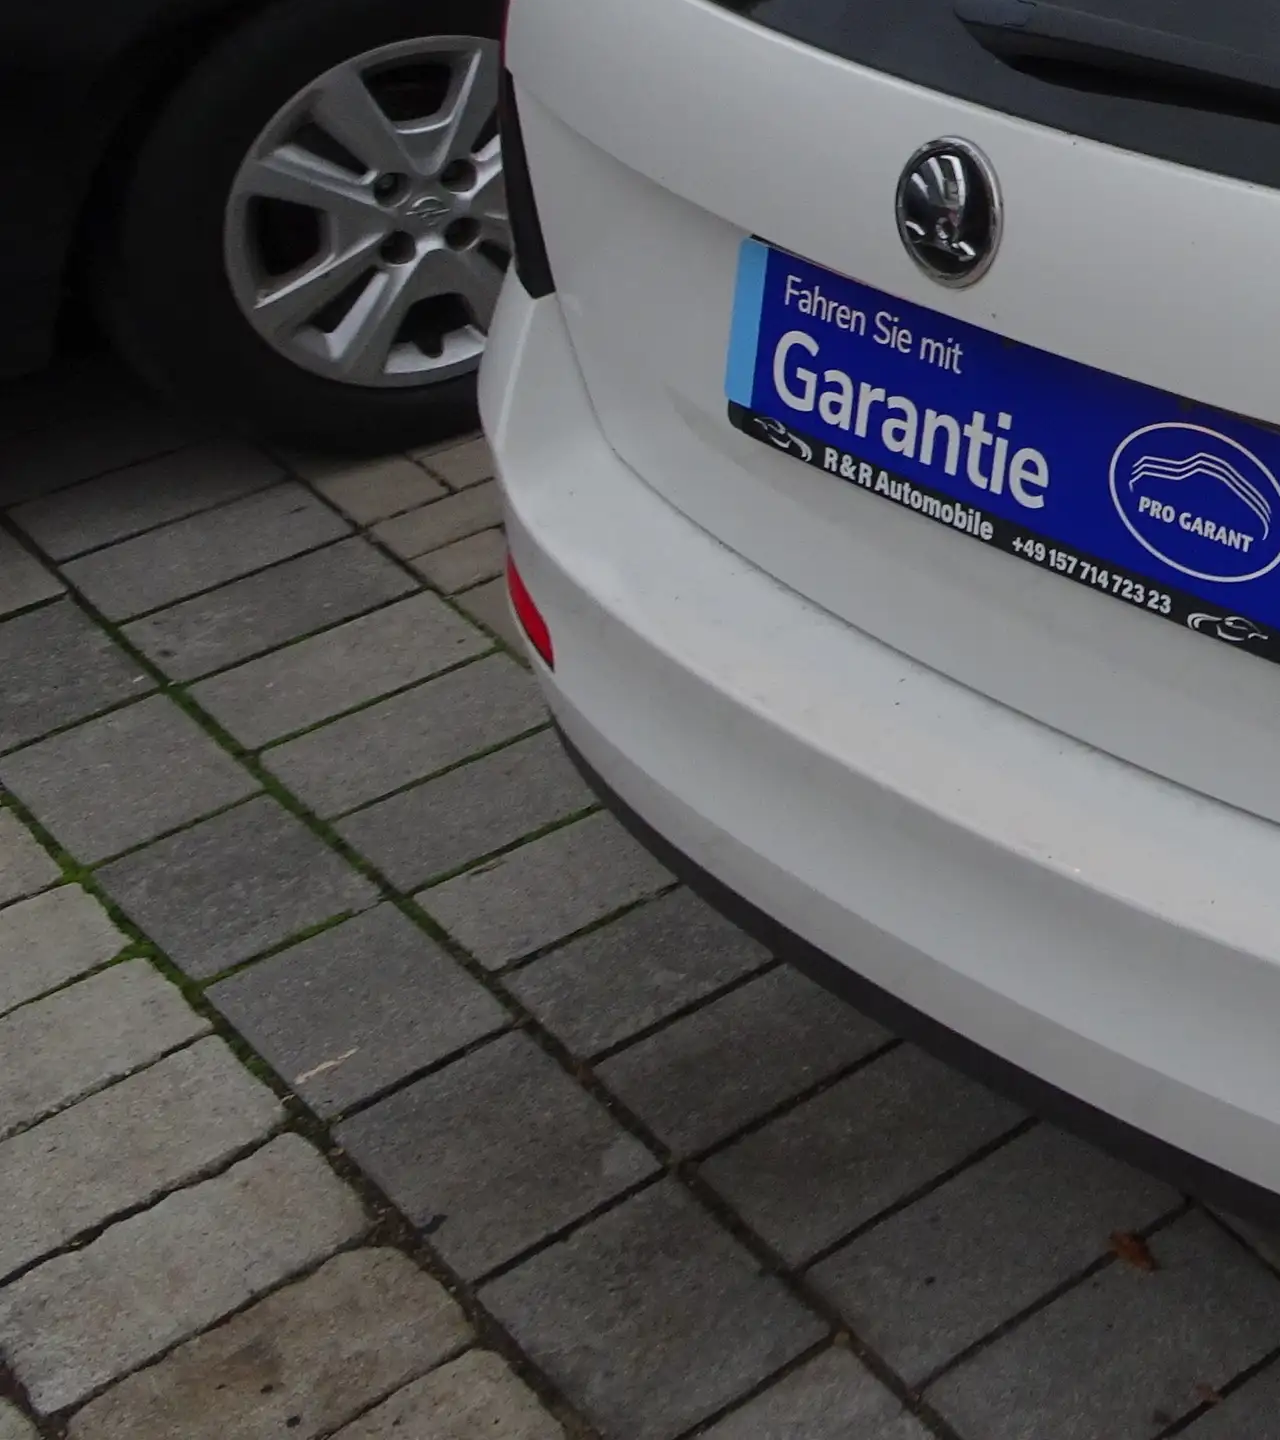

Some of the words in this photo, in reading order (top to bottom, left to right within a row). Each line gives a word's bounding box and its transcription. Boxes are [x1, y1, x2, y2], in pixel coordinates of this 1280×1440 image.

[784, 274, 867, 337] Fahren
[872, 310, 913, 354] Sie
[919, 336, 964, 375] mit
[772, 330, 1049, 510] Garantie
[874, 470, 994, 542] Automobile
[1138, 495, 1176, 524] PRO
[1178, 511, 1255, 554] GARANT
[1012, 535, 1046, 563] +49
[1049, 546, 1079, 576] 157
[1080, 560, 1110, 592] 714
[1111, 574, 1146, 606] 723
[1148, 590, 1173, 616] 23
